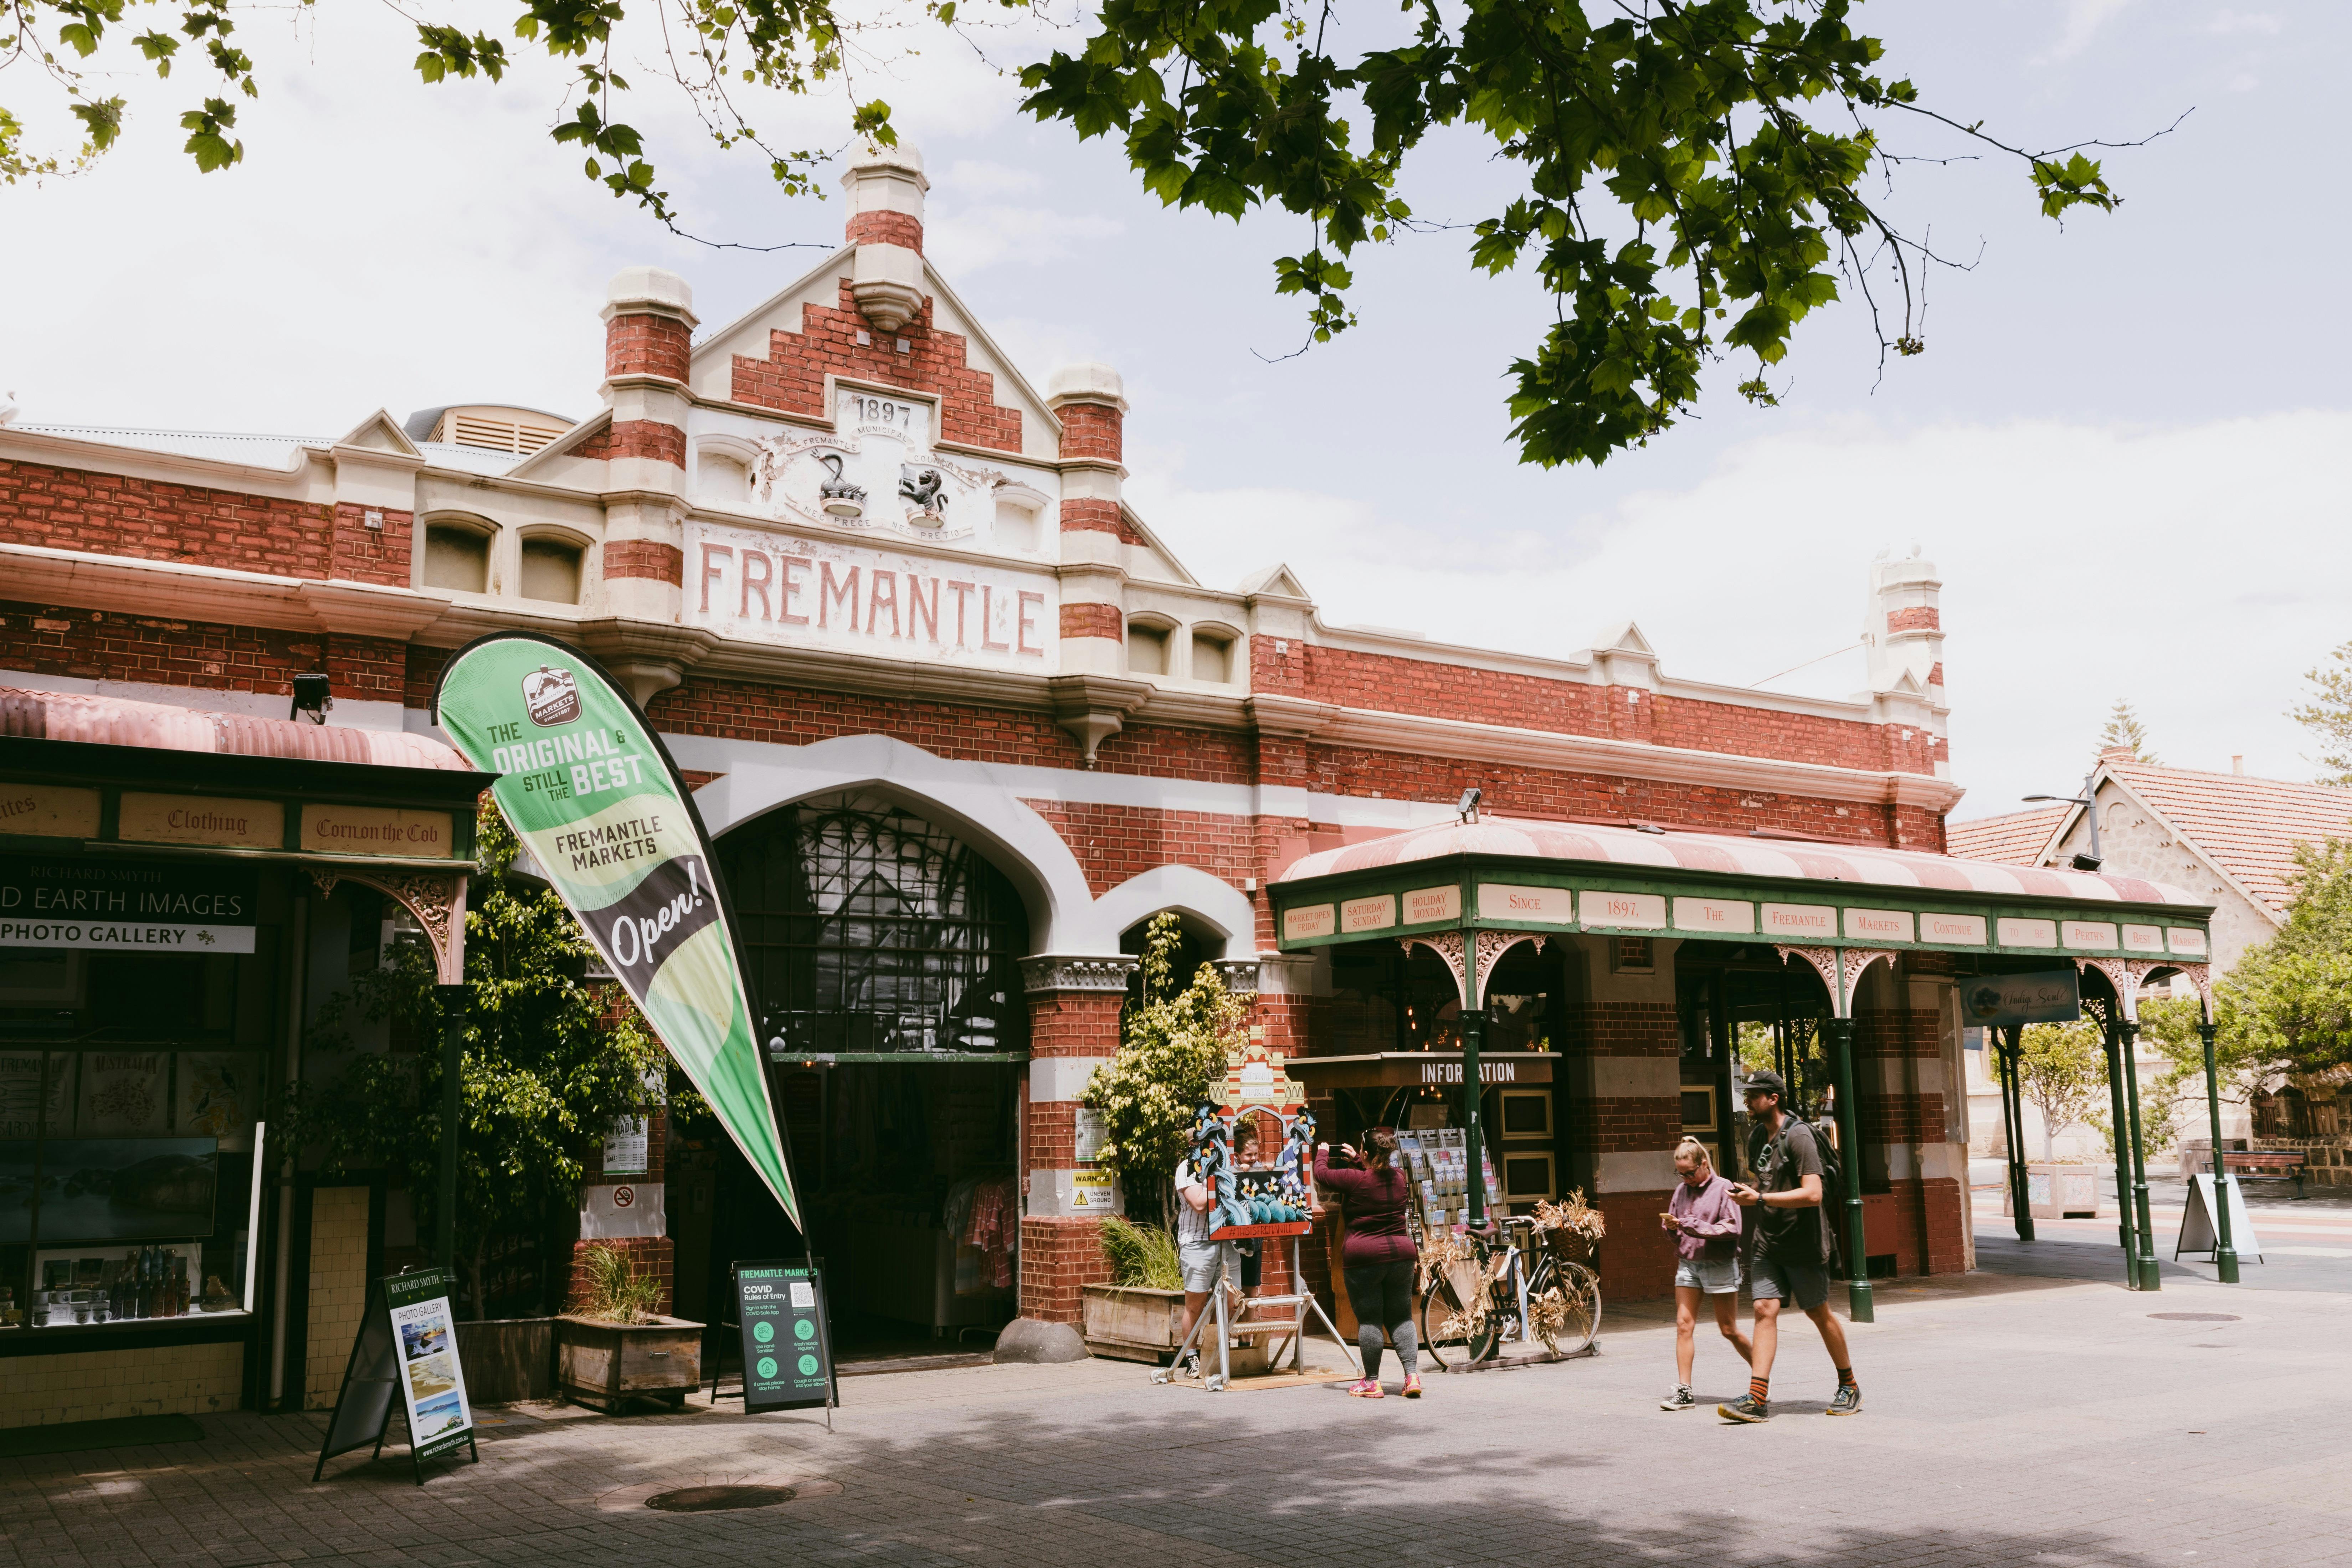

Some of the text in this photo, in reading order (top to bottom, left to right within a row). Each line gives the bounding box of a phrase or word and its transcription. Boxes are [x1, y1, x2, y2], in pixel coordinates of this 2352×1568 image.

[857, 398, 910, 426] 1897
[858, 427, 907, 442] MUNICIPAL
[803, 438, 856, 451] FREMANTLE
[804, 507, 871, 526] NEC PRECE
[892, 521, 959, 539] NEC PRETIO
[698, 542, 1044, 656] FREMANTLE
[538, 688, 565, 705] FREMANTLE
[535, 694, 574, 719] MARKETS
[487, 722, 522, 743] THE
[492, 729, 626, 776] ORIGINAL &
[523, 771, 568, 792] STILL
[570, 755, 642, 796] BEST
[548, 787, 570, 801] THE
[0, 794, 438, 844] ites Clothing Corn on the Cob
[556, 816, 662, 854] FREMANTLE
[572, 837, 657, 871] MARKETS
[30, 865, 162, 883] RICHARD SMYTH
[35, 888, 125, 911] EARTH
[140, 892, 242, 916] IMAGES
[1347, 900, 1387, 916] SATURDAY
[1412, 892, 1447, 907] HOLIDAY
[612, 861, 703, 966] Open!
[1288, 910, 1330, 924] MARKET OPEN
[1353, 913, 1382, 927] SUNDAY
[1413, 904, 1447, 919] MONDAY
[1509, 894, 2200, 948] SINCE 1897, THE FREMANTLE MARKETS CONTINUE TO BE PERTH'S BEST MARKET
[1, 924, 186, 944] PHOTO GALLERY
[1298, 921, 1320, 931] FRIDAY
[2003, 985, 2068, 1013] Indigo Soul
[1, 1058, 65, 1073] FREMANLE
[93, 1055, 157, 1074] AUSTRALIA
[1422, 1063, 1515, 1083] INFORATION
[1241, 1072, 1271, 1081] #FREMANTLE
[1246, 1088, 1271, 1097] MARKETS
[0, 1121, 58, 1137] SARDIES
[740, 1268, 818, 1279] FREMANTLE MARKES
[391, 1274, 440, 1294] RICHARD SMYTH
[744, 1285, 772, 1294] COVID
[399, 1302, 442, 1321] PHOTO GALLERY
[422, 1435, 468, 1457] www.richardsmyth.com.au
